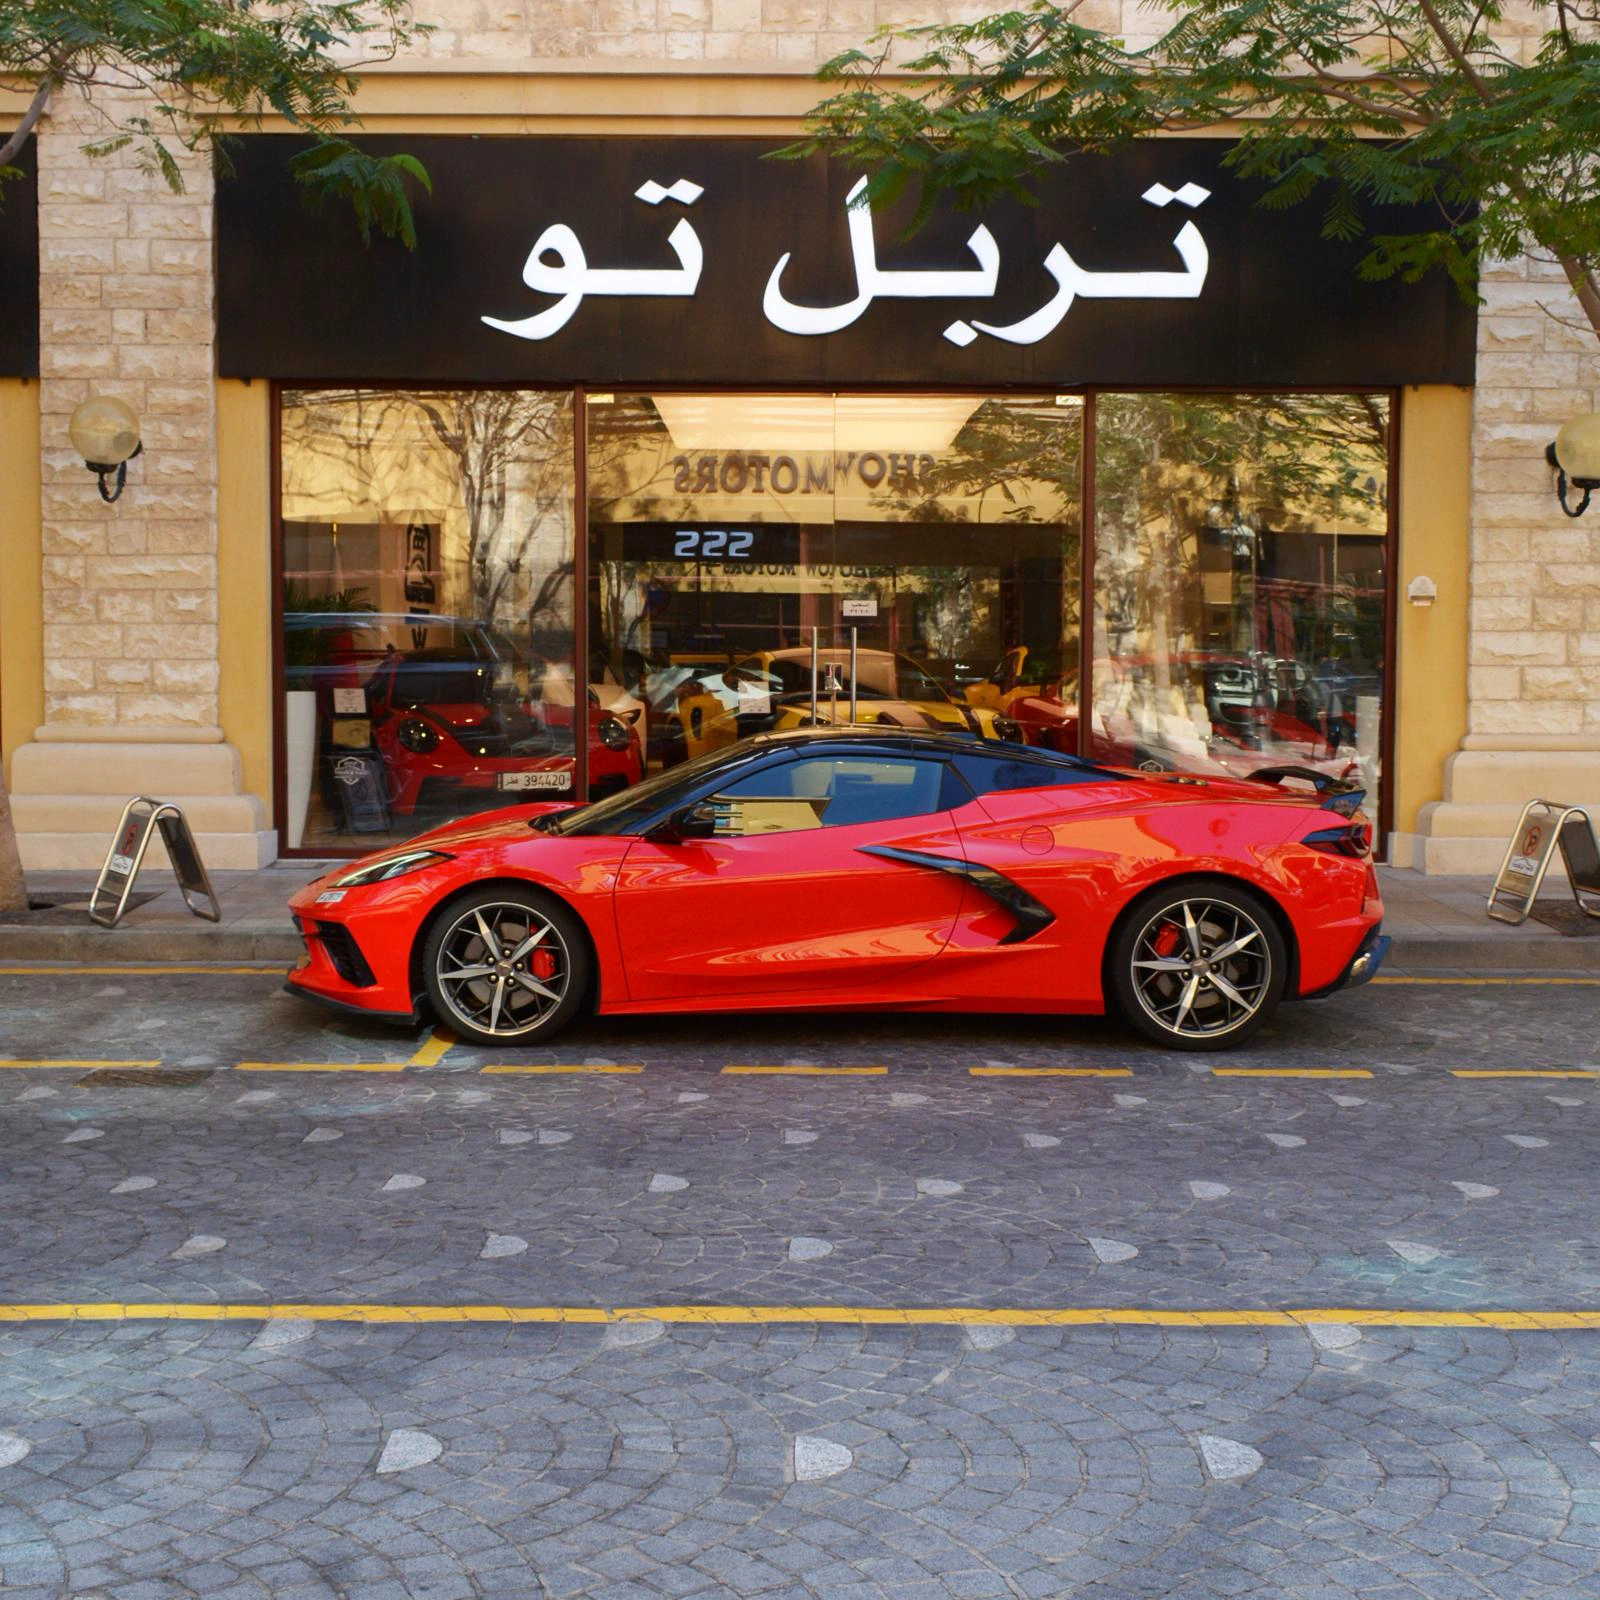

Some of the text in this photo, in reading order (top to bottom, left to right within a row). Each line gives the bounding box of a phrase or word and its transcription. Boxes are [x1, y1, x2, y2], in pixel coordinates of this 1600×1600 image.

[480, 178, 705, 341] تو
[674, 530, 754, 557] 222
[524, 774, 565, 787] 394420
